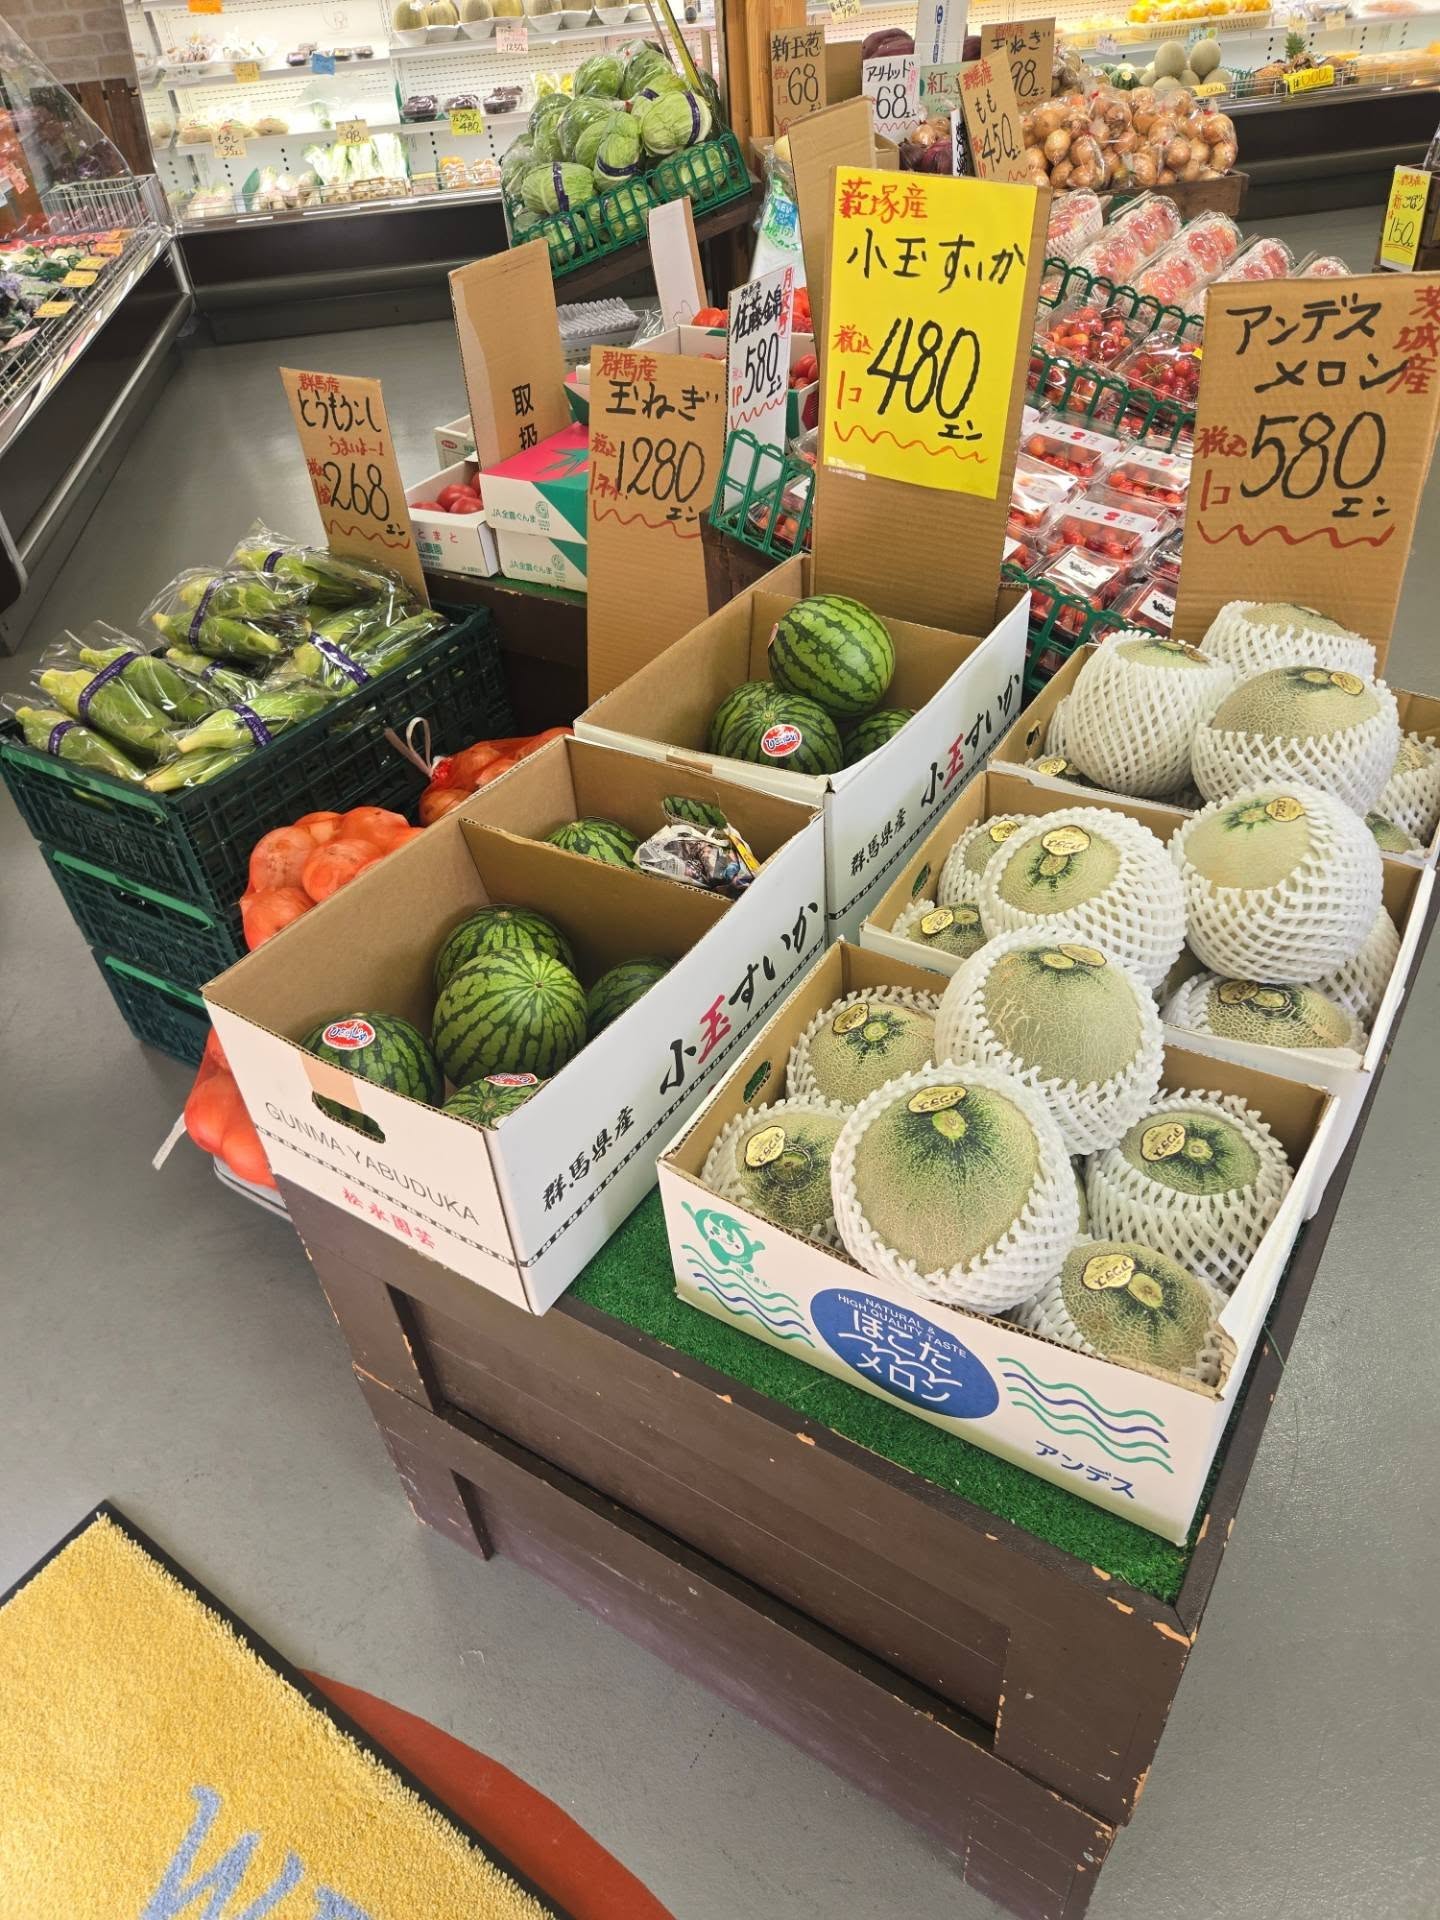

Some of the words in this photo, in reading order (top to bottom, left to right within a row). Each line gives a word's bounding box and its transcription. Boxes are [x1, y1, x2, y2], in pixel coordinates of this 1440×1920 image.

[788, 63, 819, 106] 68
[876, 83, 908, 119] 68
[982, 112, 1014, 173] 450
[846, 227, 1026, 294] 小玉すいか
[1226, 292, 1383, 356] アンデス
[742, 332, 779, 404] 580
[832, 323, 875, 356] 税込
[866, 316, 981, 420] 480
[937, 419, 983, 441] エン
[1254, 353, 1410, 394] メロン
[605, 380, 719, 422] 玉ねぎ
[323, 461, 390, 522] 268
[617, 437, 705, 503] 1280
[666, 506, 698, 522] エン
[1240, 411, 1387, 500] 580
[1331, 495, 1392, 518] エン
[659, 900, 821, 1096] 小玉すいか
[264, 1101, 345, 1158] GUNMA
[350, 1149, 481, 1227] YABUDUKA
[543, 1105, 635, 1213] 群馬県産
[837, 1293, 867, 1313] HIGH
[870, 1307, 923, 1337] QUALITY
[926, 1334, 968, 1359] TASTE
[852, 1309, 953, 1375] ほこた
[864, 1297, 924, 1329] NATURAL
[856, 1352, 951, 1402] メロン
[1035, 1439, 1135, 1500] アンデス
